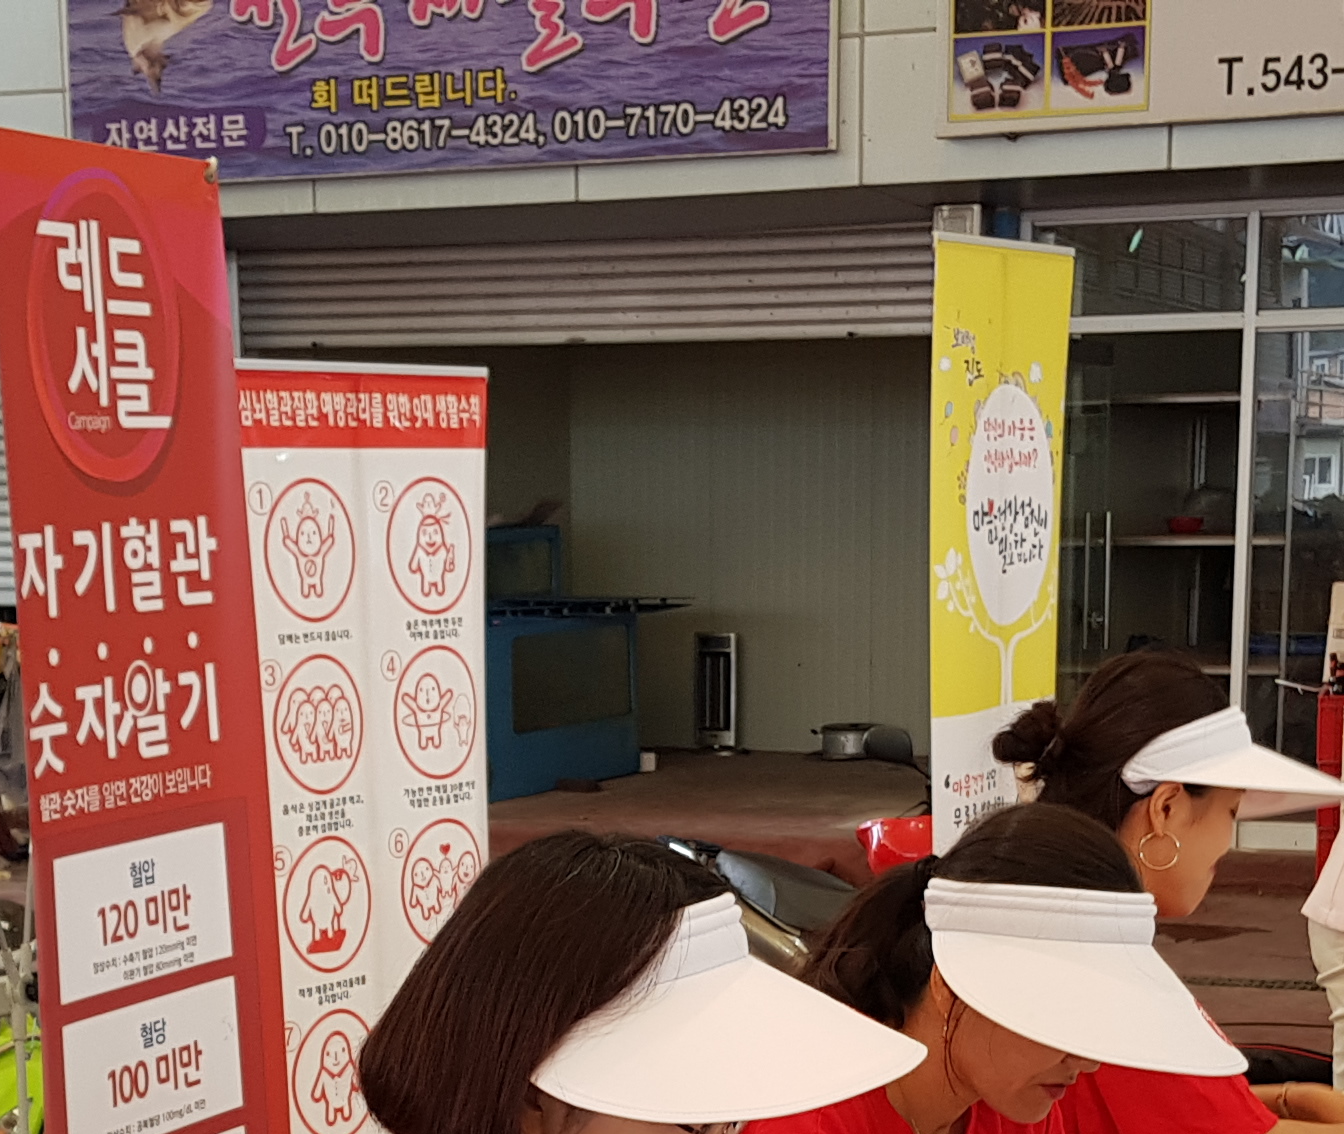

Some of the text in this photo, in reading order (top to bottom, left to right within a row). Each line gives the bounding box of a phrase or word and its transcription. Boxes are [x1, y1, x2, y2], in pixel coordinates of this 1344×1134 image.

[311, 78, 338, 114] 회
[553, 96, 788, 143] 010-7170-4324
[104, 114, 248, 151] 자연산전문
[36, 219, 152, 317] 레드
[67, 325, 173, 430] 서클
[238, 389, 320, 428] 심뇌혈관질환
[386, 393, 411, 431] 위한
[436, 394, 482, 429] 생활수칙
[17, 514, 218, 619] 자기혈관
[129, 857, 156, 889] 혈압
[97, 883, 192, 947] 120 미만
[140, 1017, 167, 1049] 혈당
[106, 1039, 203, 1108] 100 미만
